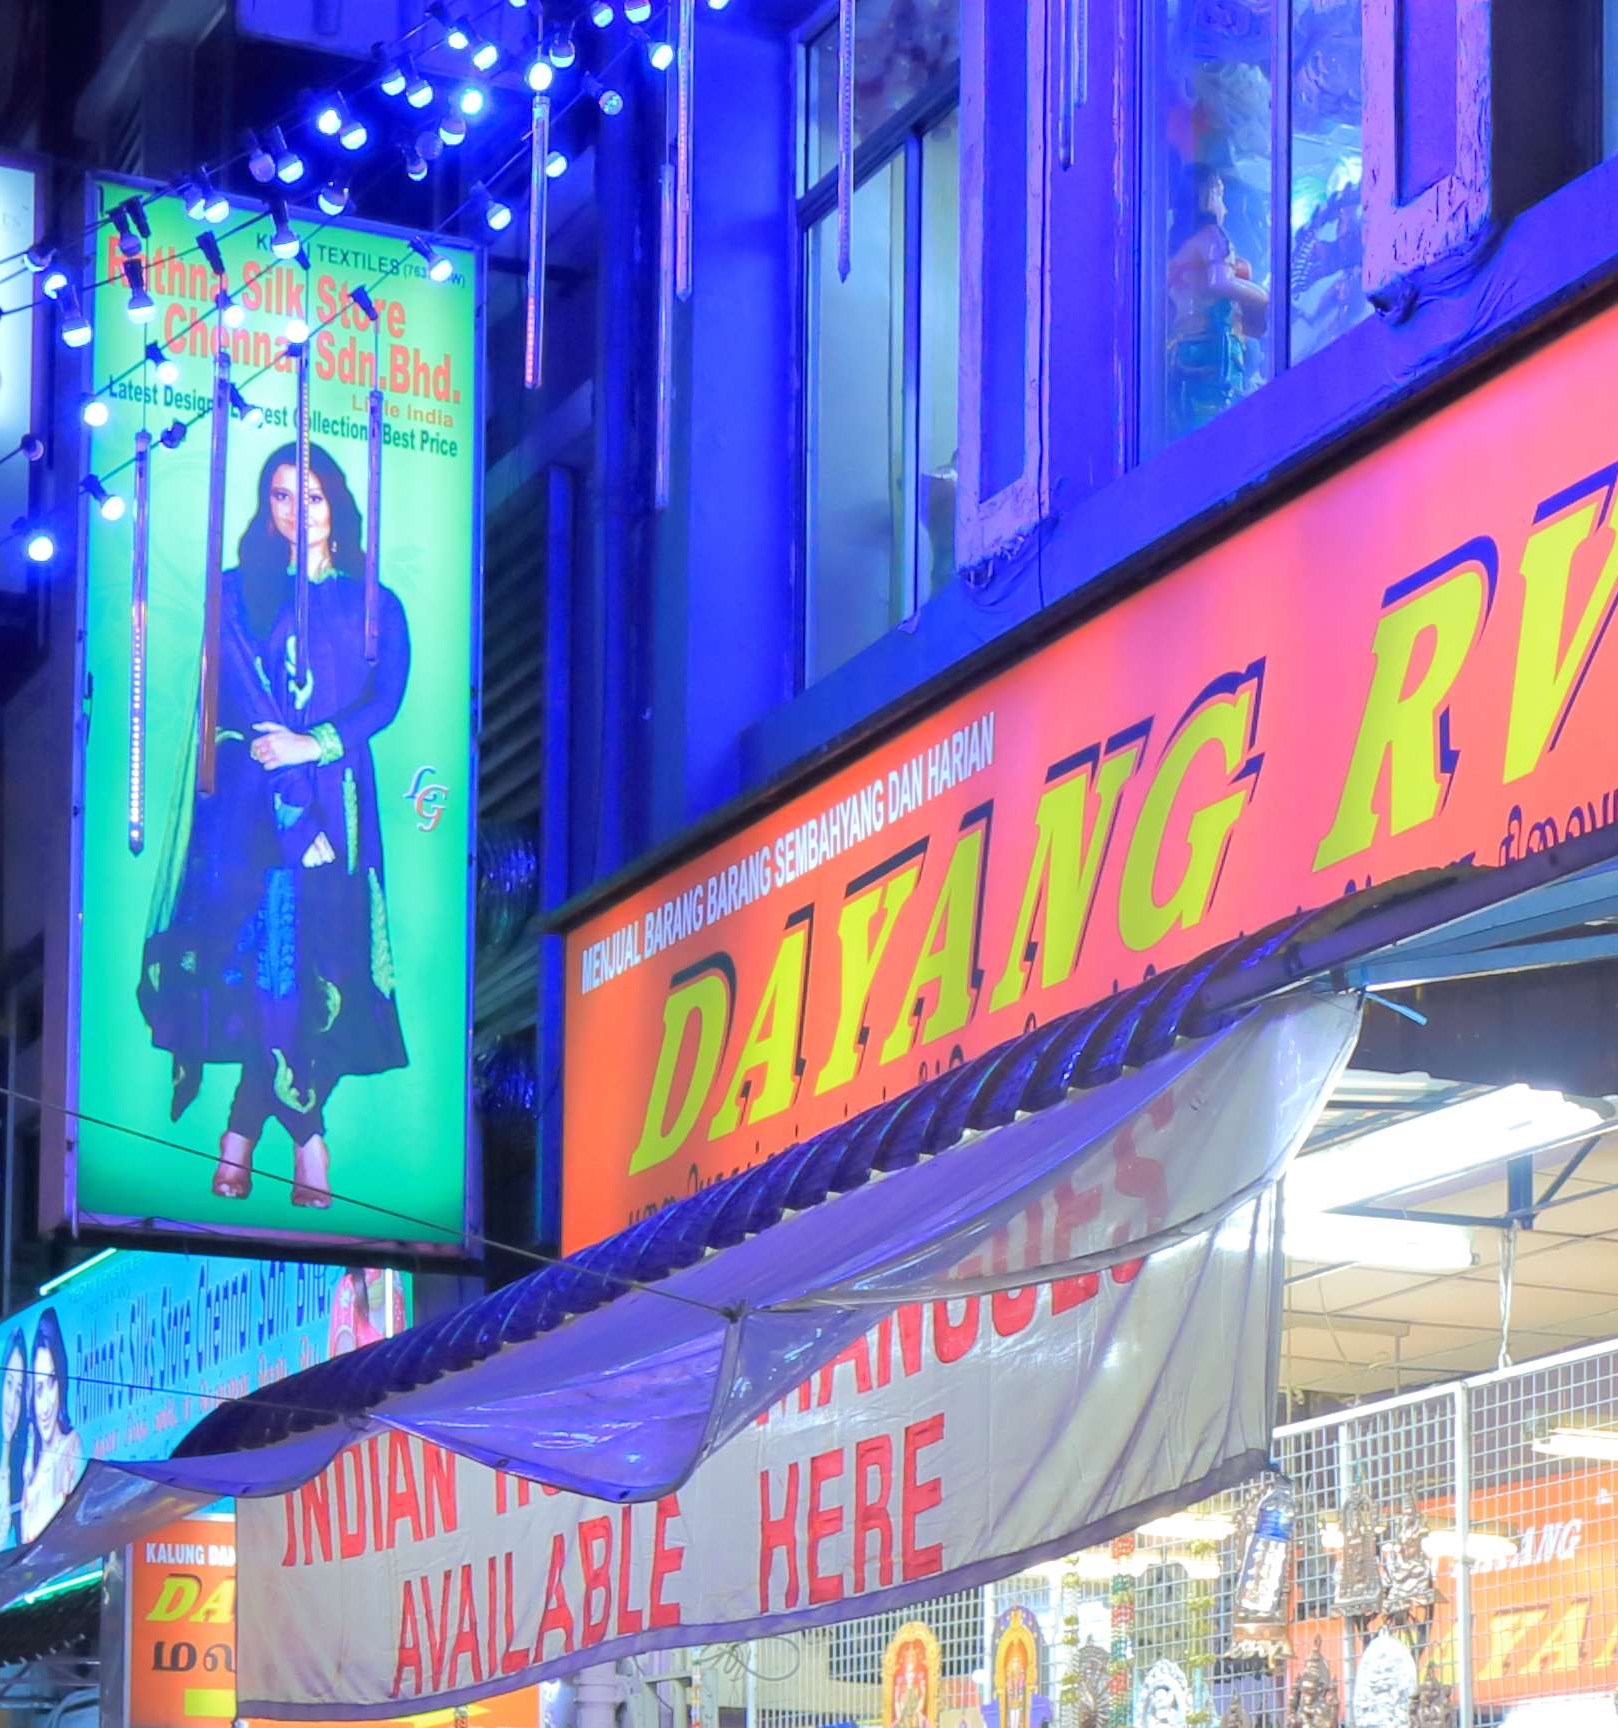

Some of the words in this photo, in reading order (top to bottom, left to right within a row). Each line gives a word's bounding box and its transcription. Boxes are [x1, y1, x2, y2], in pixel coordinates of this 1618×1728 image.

[241, 260, 304, 320] Silk
[108, 374, 159, 405] Latest
[419, 430, 459, 458] Price
[406, 403, 456, 429] India
[581, 920, 642, 995] MENJUAL
[644, 884, 705, 960] BARANG
[706, 846, 772, 926] BARANG
[774, 779, 884, 888] SEMBAHYANG
[887, 753, 924, 825] DAN
[927, 711, 995, 801] HARIAN
[629, 657, 1267, 1177] DAYANG
[159, 1285, 192, 1390] Store
[196, 1256, 253, 1375] Chennai
[145, 1543, 205, 1565] KALUNG
[281, 1430, 457, 1568] INDIAN
[391, 1490, 684, 1698] AVAILABLE
[758, 1412, 945, 1615] HERE
